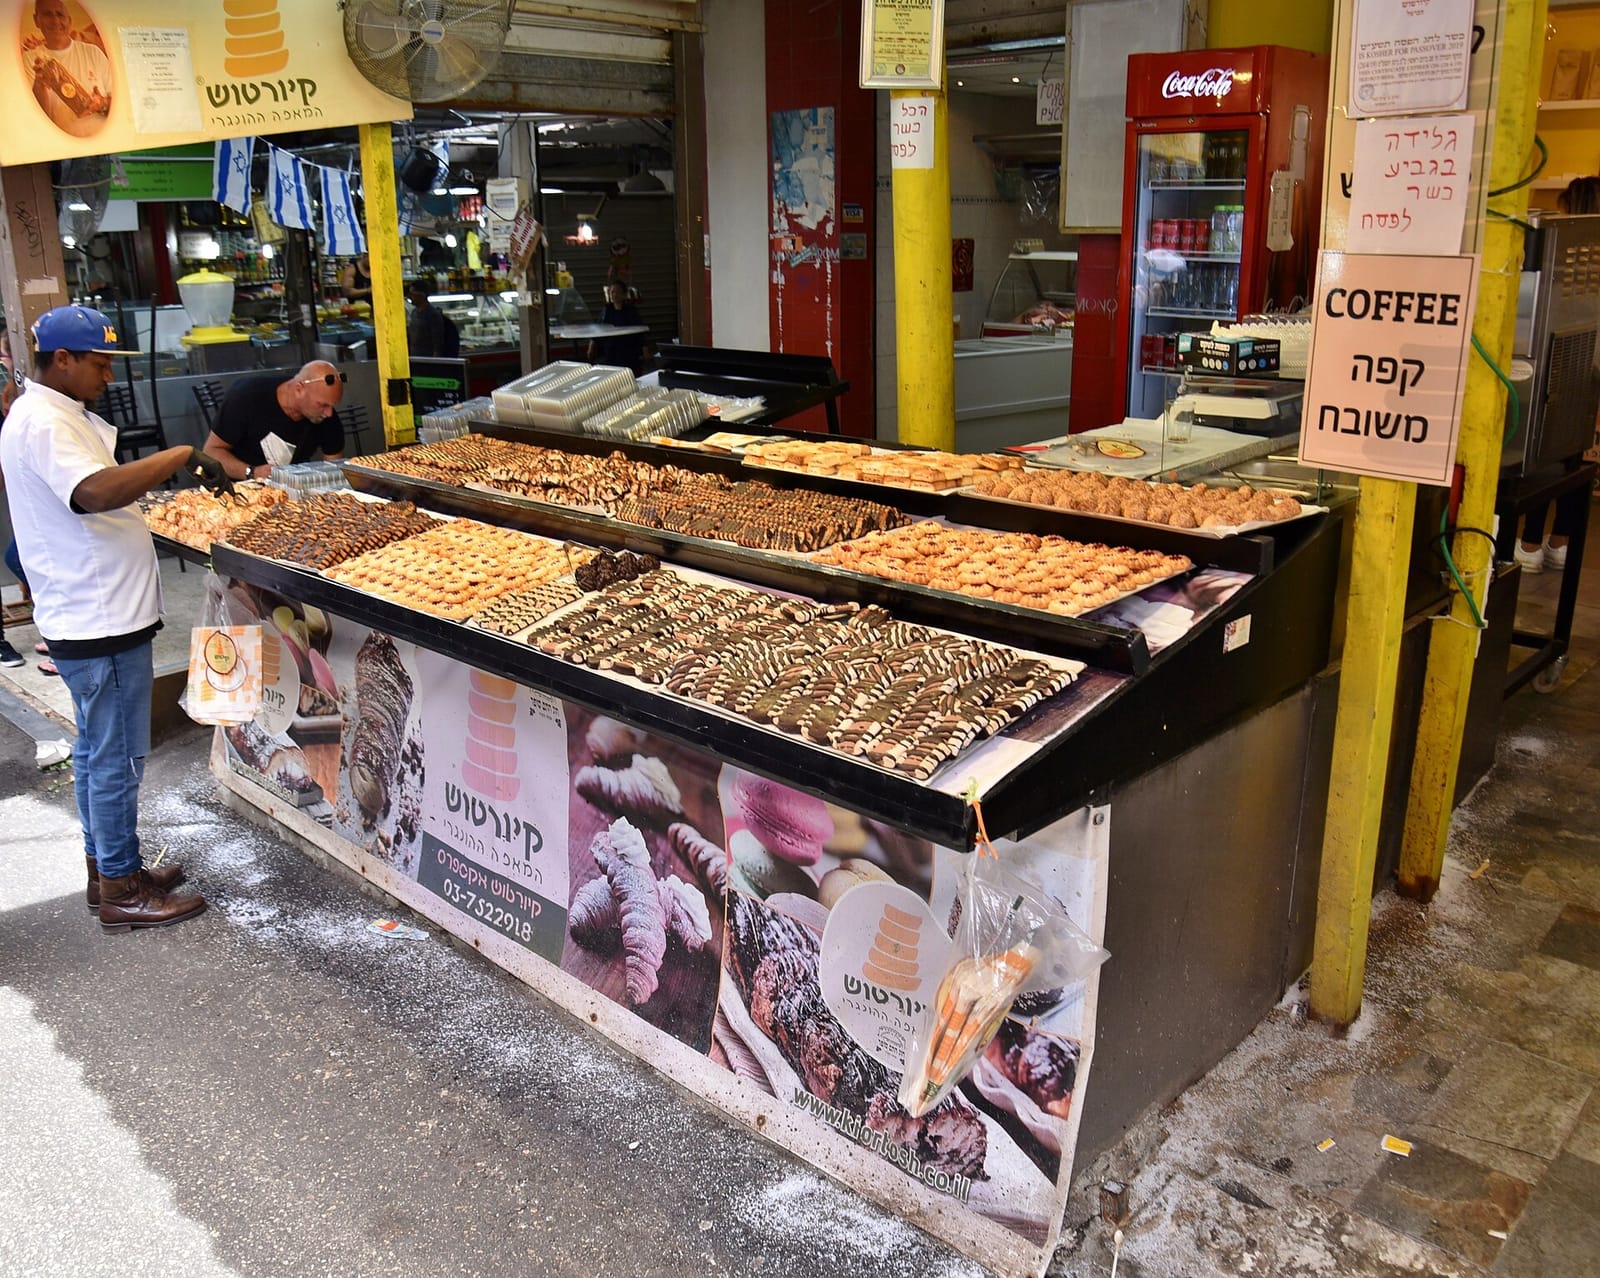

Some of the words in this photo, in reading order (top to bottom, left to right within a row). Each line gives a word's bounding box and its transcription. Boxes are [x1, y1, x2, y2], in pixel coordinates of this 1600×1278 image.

[206, 78, 317, 109] קיורטוש
[1162, 68, 1234, 99] Coca-Cola
[211, 112, 266, 128] ההונגרי
[272, 107, 323, 122] המאפה
[901, 102, 928, 117] הכל
[893, 122, 921, 135] כשר
[1384, 126, 1457, 152] גלידה
[891, 140, 917, 158] לפס
[1384, 159, 1457, 178] בגביע
[1407, 185, 1453, 201] כשר
[1361, 207, 1412, 233] לפסח
[1325, 288, 1461, 326] COFFEE
[1351, 354, 1425, 397] קפה
[1318, 404, 1429, 443] משובח
[265, 687, 286, 709] קיור
[443, 818, 485, 855] ההונגרי
[445, 781, 544, 862] קיורטוש
[437, 848, 488, 889] אקספרס
[490, 846, 543, 885] המאפה
[443, 878, 534, 943] 03-7522918
[490, 878, 542, 919] קיורטוש
[843, 973, 927, 1018] יורטוש
[793, 1086, 972, 1205] www.kiortosh.co.il
